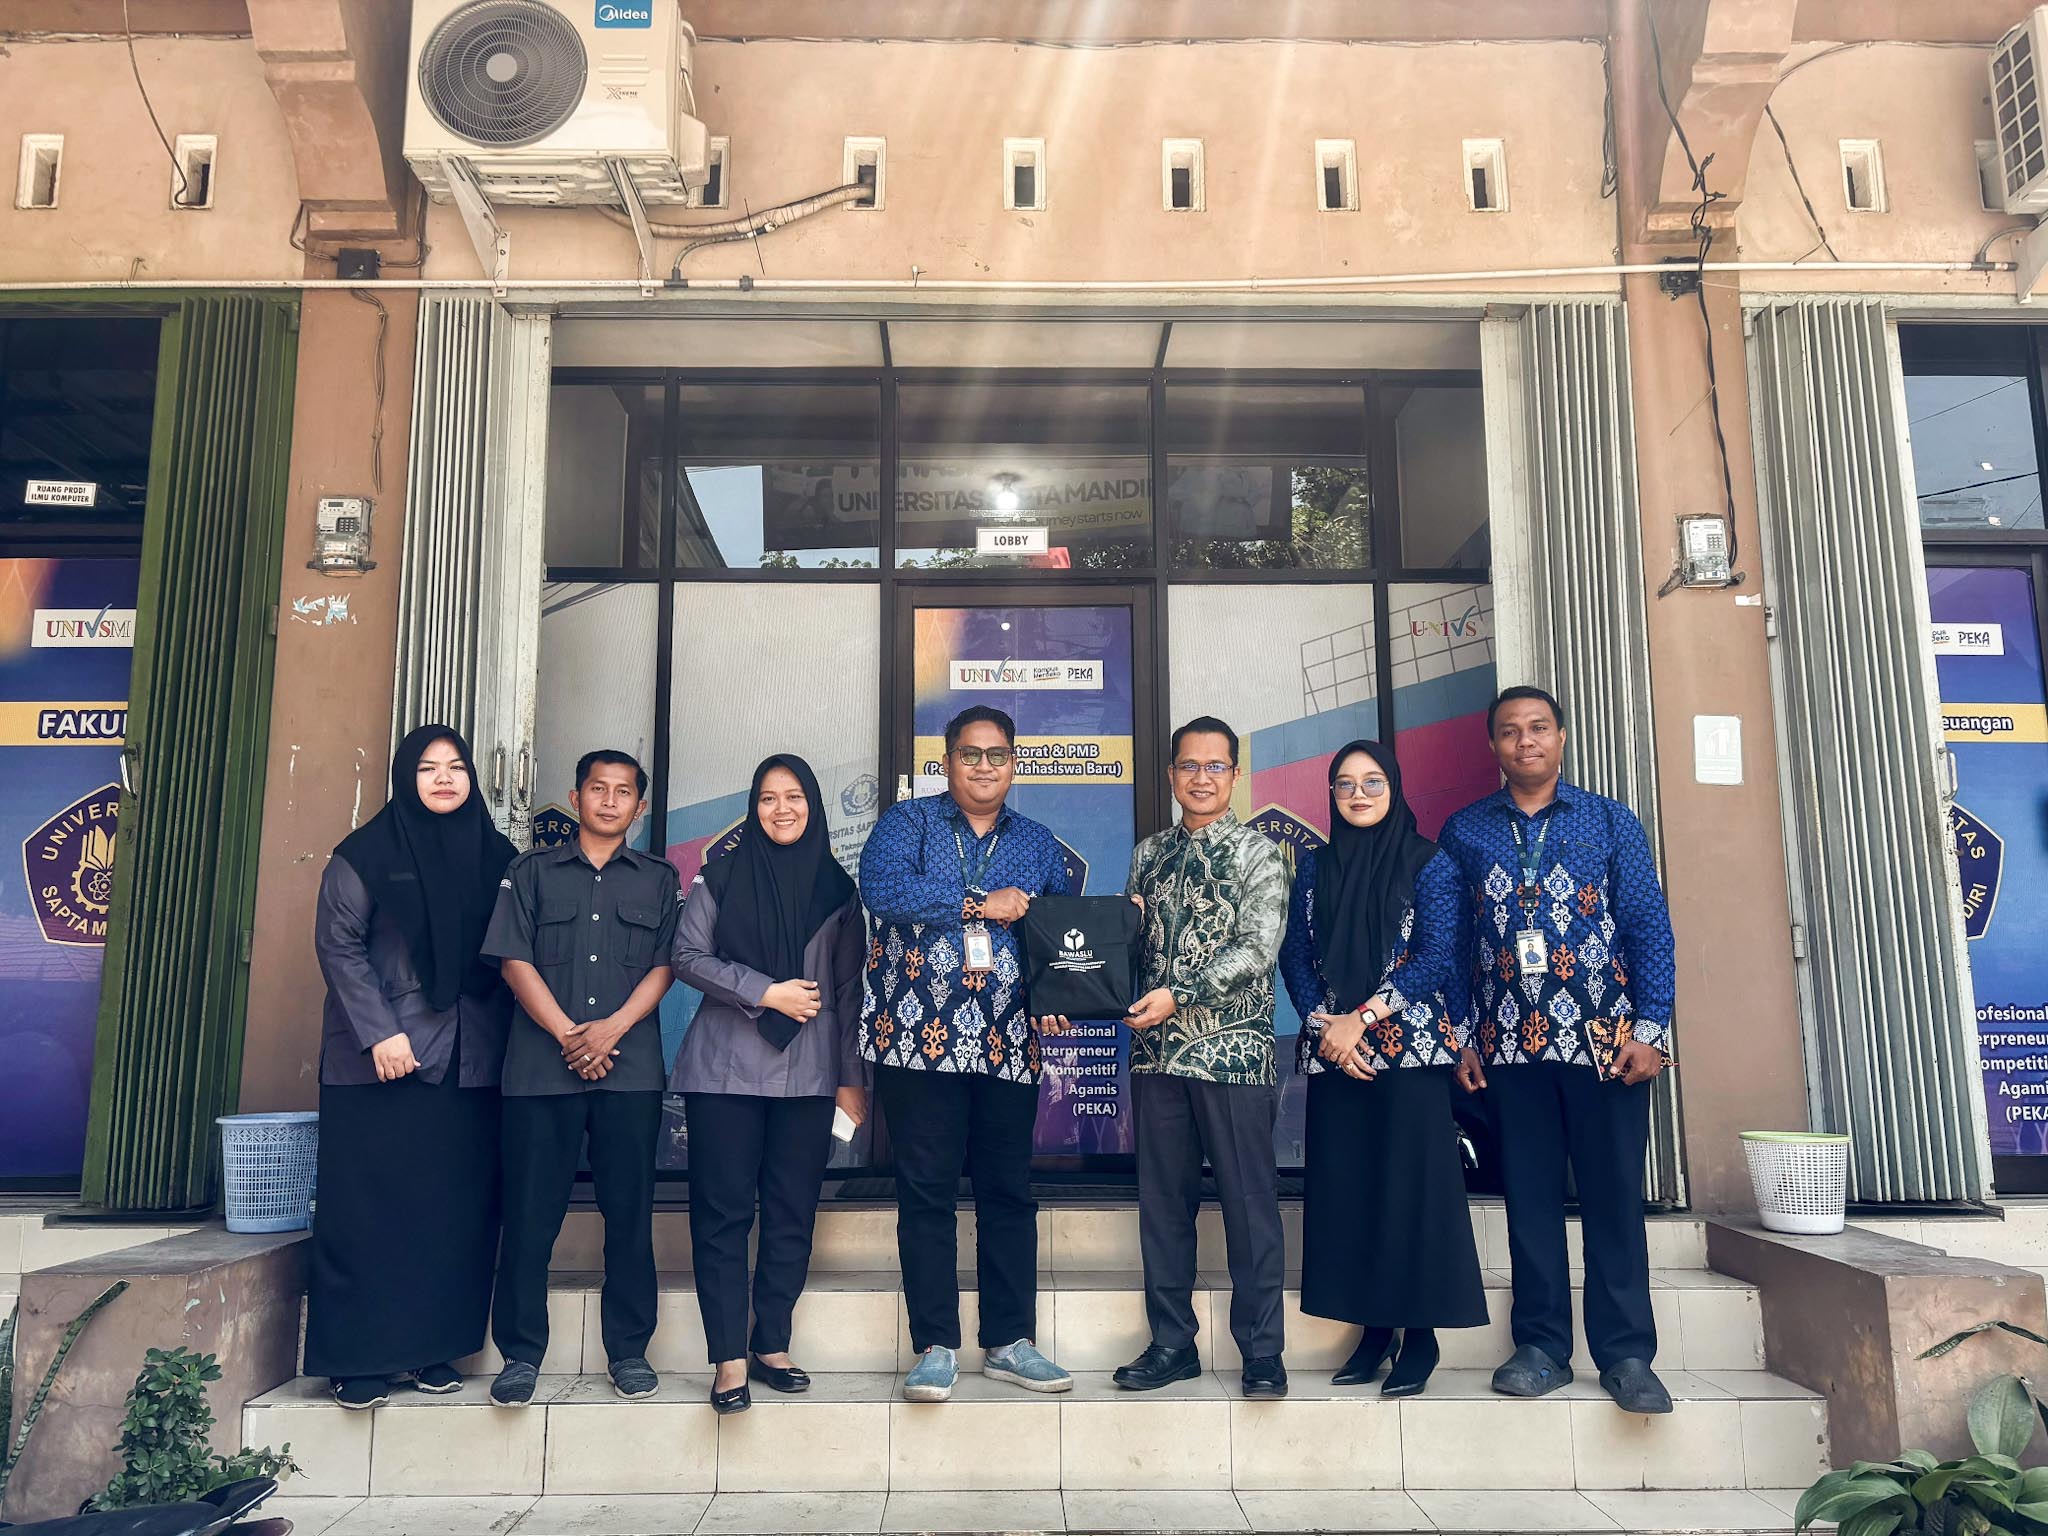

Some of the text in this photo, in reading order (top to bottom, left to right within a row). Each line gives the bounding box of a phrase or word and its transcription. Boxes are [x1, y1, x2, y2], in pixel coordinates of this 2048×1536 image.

[598, 4, 649, 22] Midea
[36, 485, 86, 494] RUANG PRODI
[31, 493, 90, 503] ILMU KOMPUTER
[994, 535, 1029, 546] LOBBY
[1958, 631, 1990, 645] PEKA
[1068, 667, 1093, 680] PEKA
[1942, 717, 2013, 733] euangan
[1051, 745, 1066, 758] &
[1068, 745, 1099, 758] PMB
[1014, 763, 1083, 775] Mahasiswa
[1086, 762, 1122, 777] Baru)
[1059, 949, 1093, 958] BAWASLU
[1049, 1063, 1117, 1079] Kompetitif
[1068, 1083, 1118, 1099] Agamis
[1072, 1102, 1117, 1117] (PEKA)
